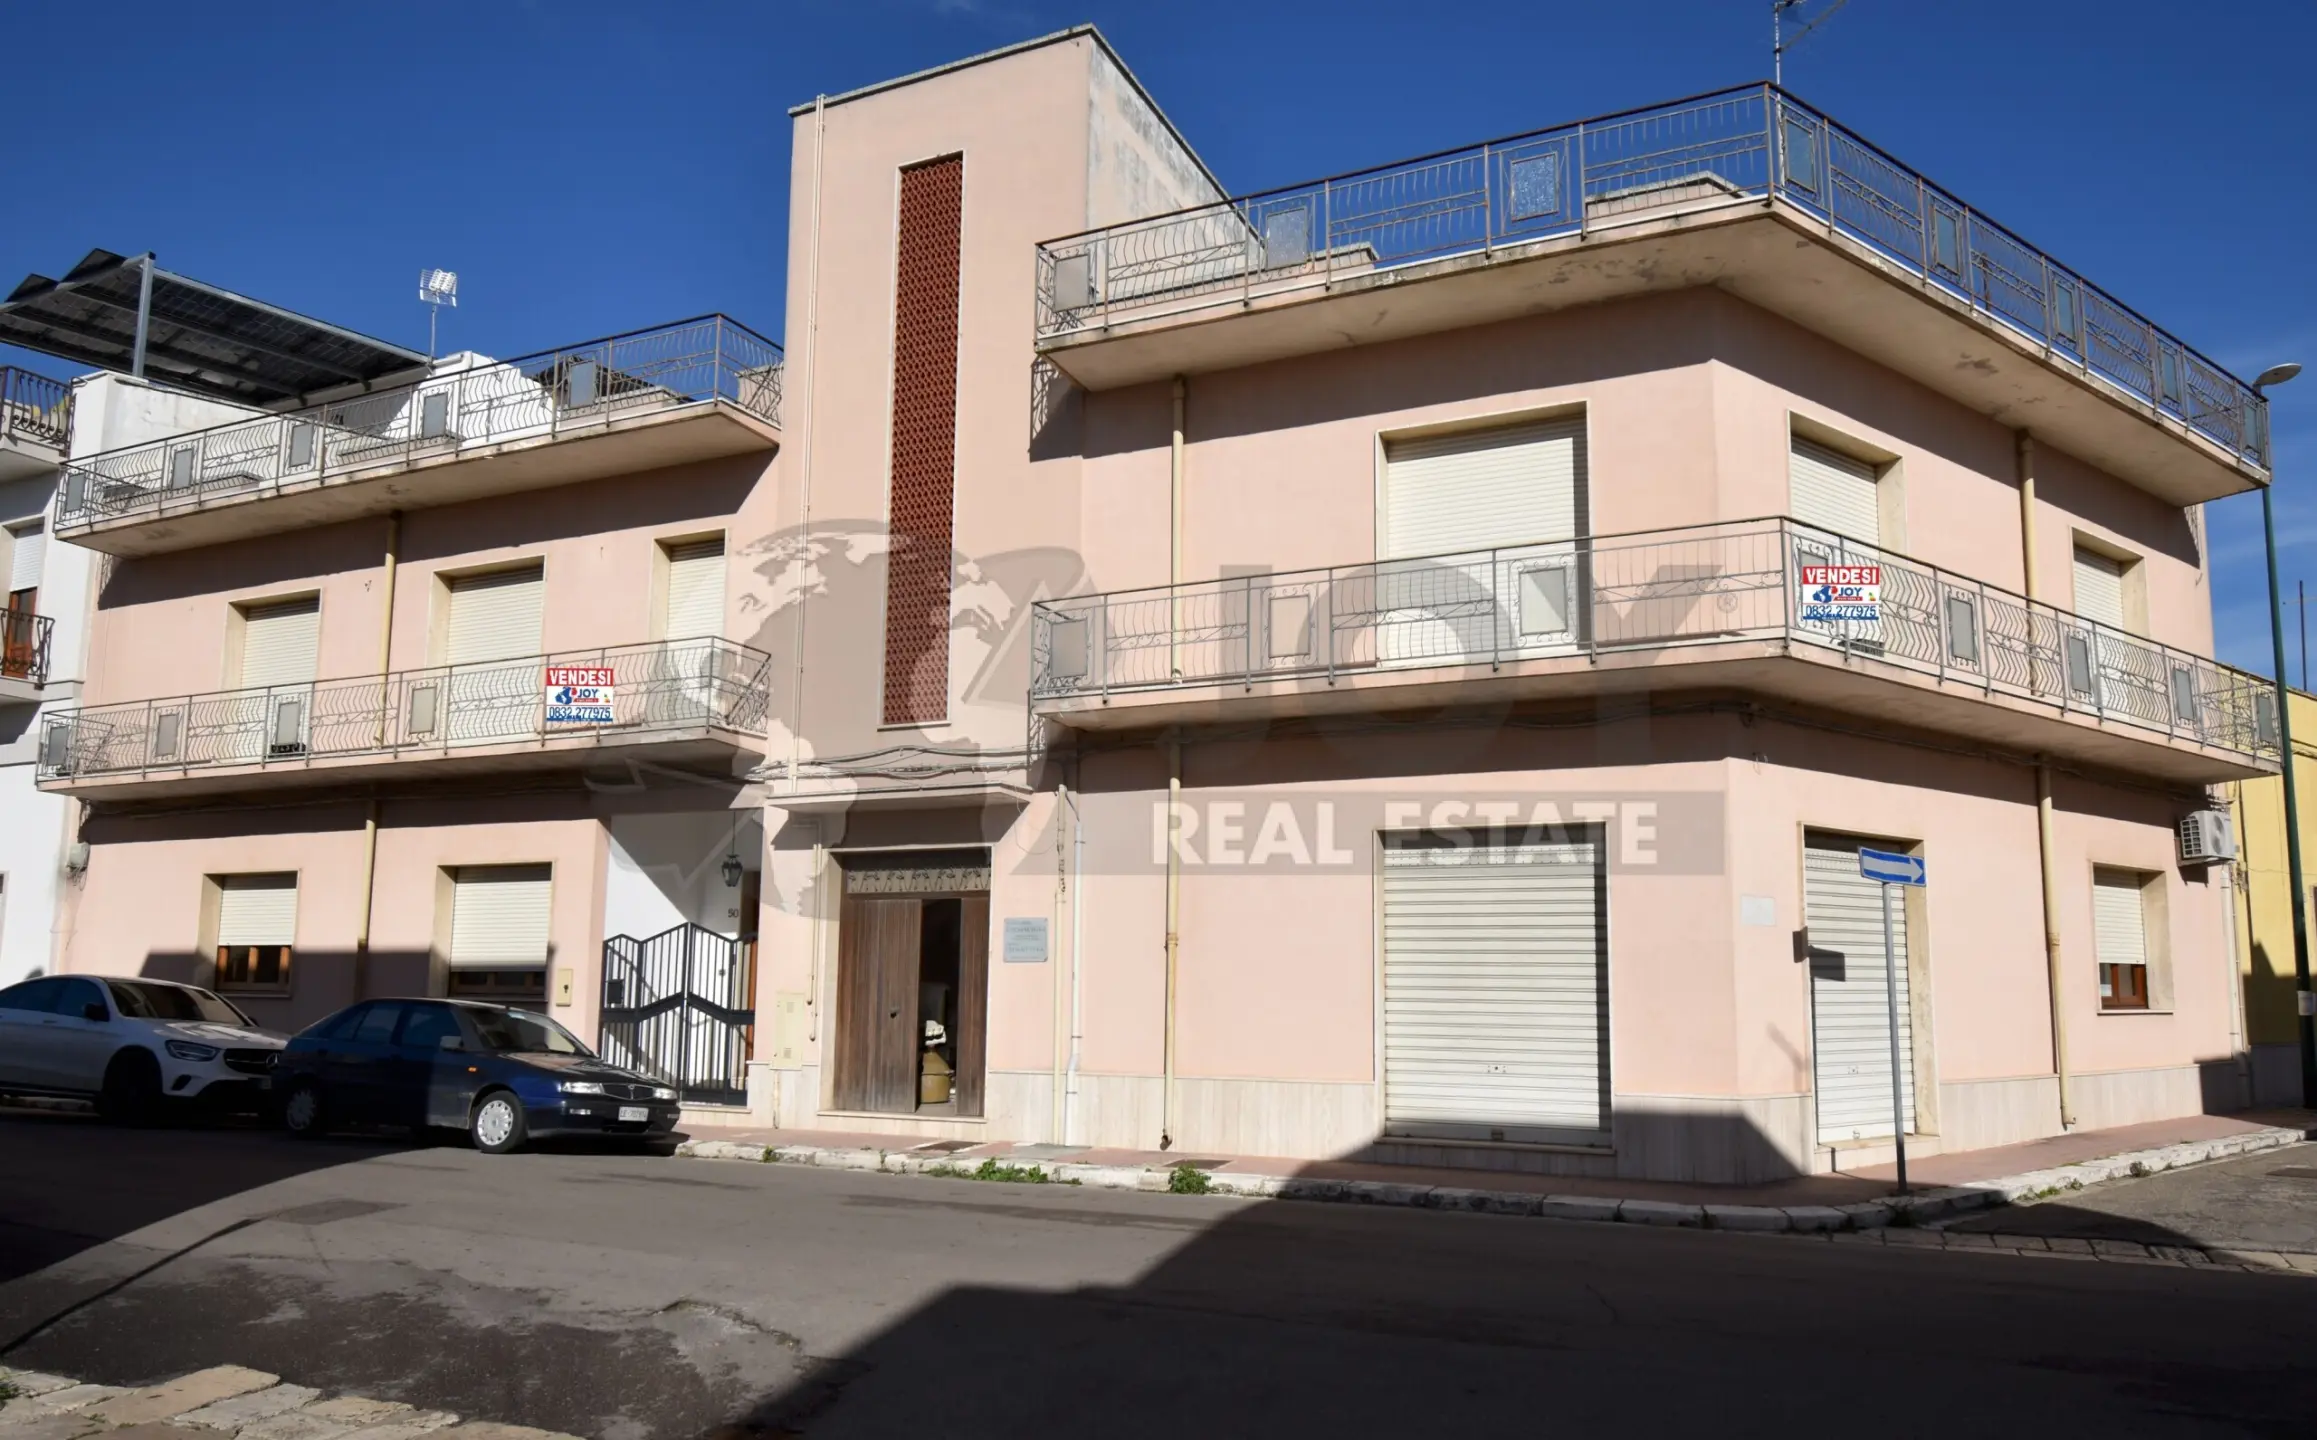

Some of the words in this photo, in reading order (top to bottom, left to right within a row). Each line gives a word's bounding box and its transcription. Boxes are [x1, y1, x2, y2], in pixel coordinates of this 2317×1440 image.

[1805, 567, 1877, 584] VENDESI
[1838, 586, 1863, 597] JOY
[549, 669, 611, 685] VENDESI
[577, 688, 600, 698] JOY
